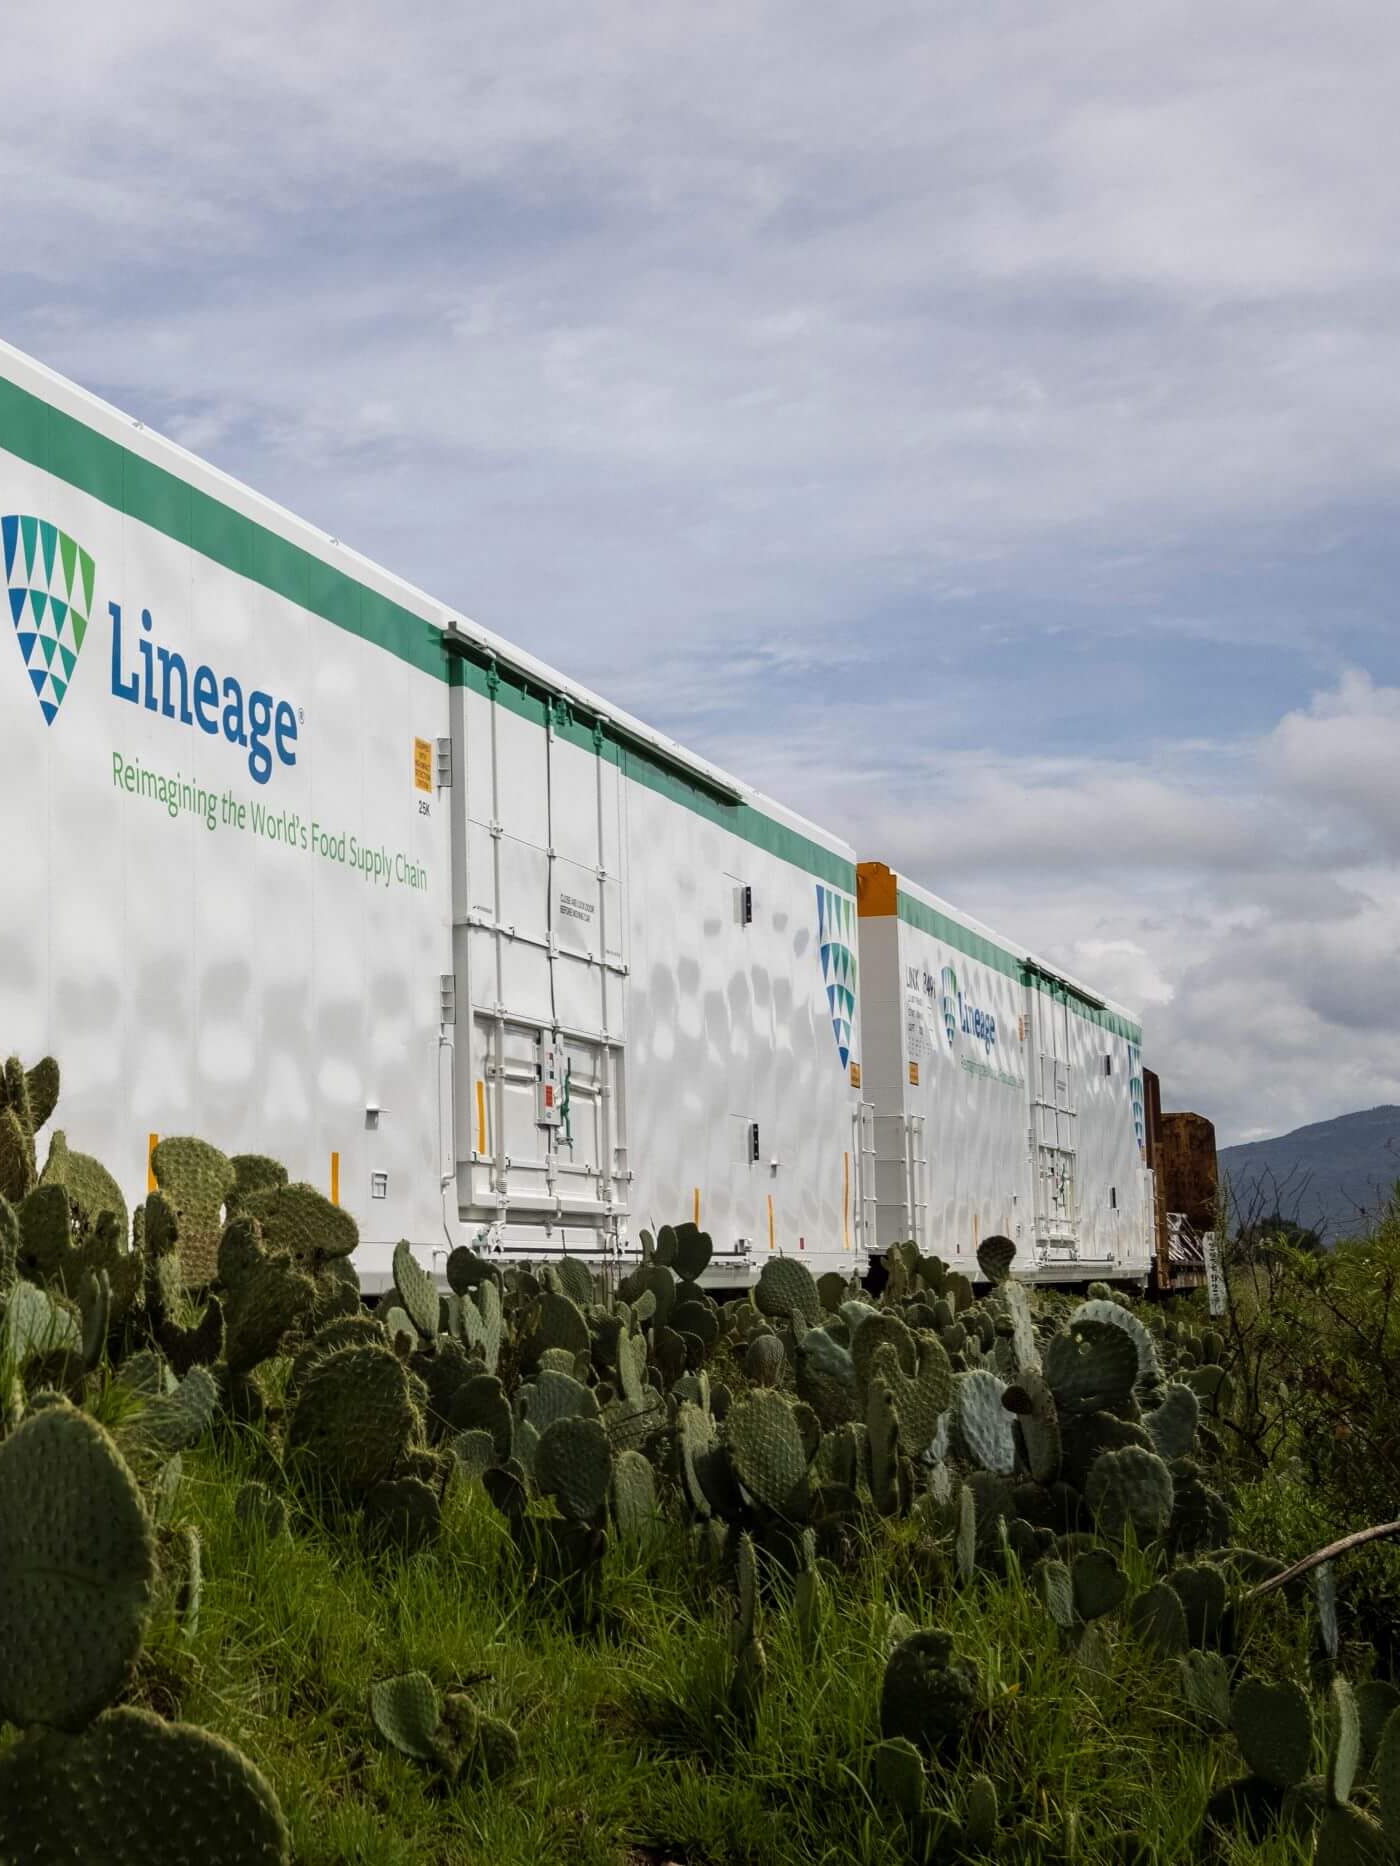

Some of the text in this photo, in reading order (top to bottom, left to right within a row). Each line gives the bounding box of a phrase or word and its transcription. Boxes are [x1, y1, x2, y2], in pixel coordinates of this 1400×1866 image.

[108, 601, 298, 785] Lineage
[112, 751, 218, 831] Reimagining
[221, 789, 246, 830] the
[311, 822, 346, 863] Food
[350, 836, 393, 887] Supply
[395, 853, 428, 892] Chain
[958, 991, 996, 1056] Lineage
